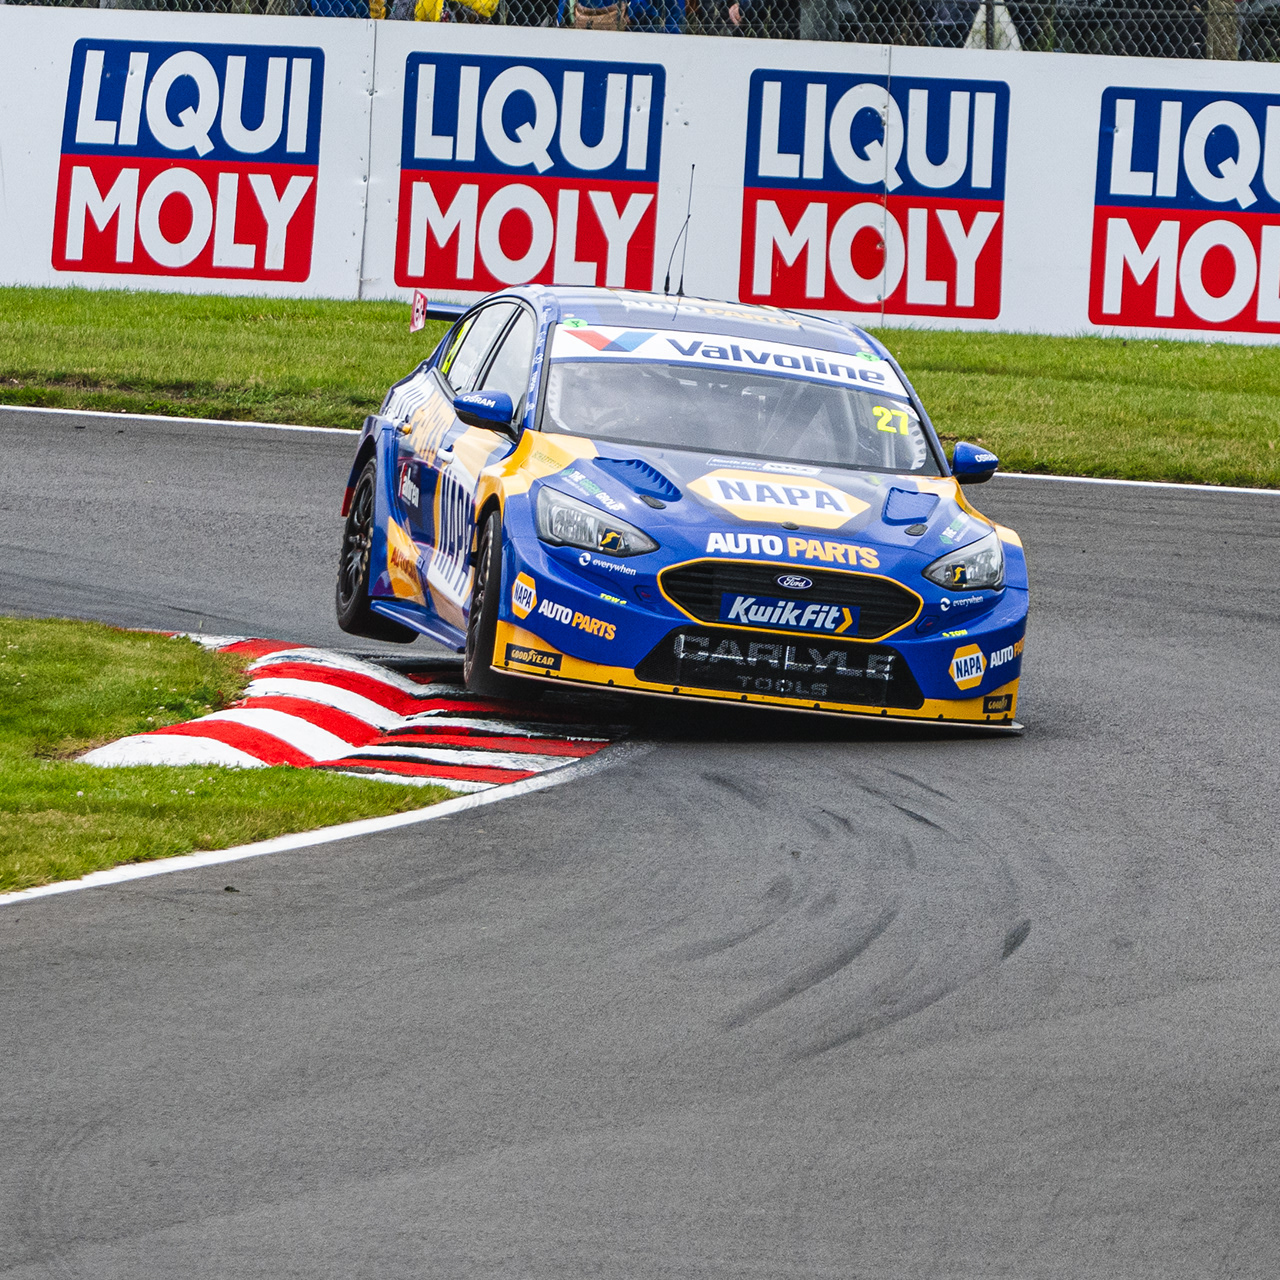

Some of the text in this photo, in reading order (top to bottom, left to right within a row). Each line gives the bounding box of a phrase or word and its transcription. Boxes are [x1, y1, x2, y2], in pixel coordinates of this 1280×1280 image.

[75, 50, 312, 158] LIQUI
[414, 64, 653, 173] LIQUI
[757, 81, 996, 192] LIQUI
[65, 166, 313, 270] MOLY
[407, 181, 654, 287] MOLY
[752, 199, 1000, 307] MOLY
[621, 300, 701, 314] AUTO
[665, 338, 885, 386] Valvoline
[463, 394, 497, 408] OSRAM
[872, 405, 909, 436] 27
[717, 479, 844, 513] NAPA
[706, 532, 881, 569] AUTO PARTS
[592, 558, 637, 576] everywhen
[782, 576, 807, 588] Ford
[514, 582, 533, 609] NAPA
[600, 592, 621, 603] TOW
[952, 595, 984, 607] everywhen
[538, 599, 617, 640] AUTO PARTS
[511, 649, 555, 666] GOODYEAR
[674, 634, 897, 680] CARLYLE
[956, 655, 982, 679] NAPA
[990, 645, 1014, 668] AUTO
[737, 675, 830, 697] TOOLS
